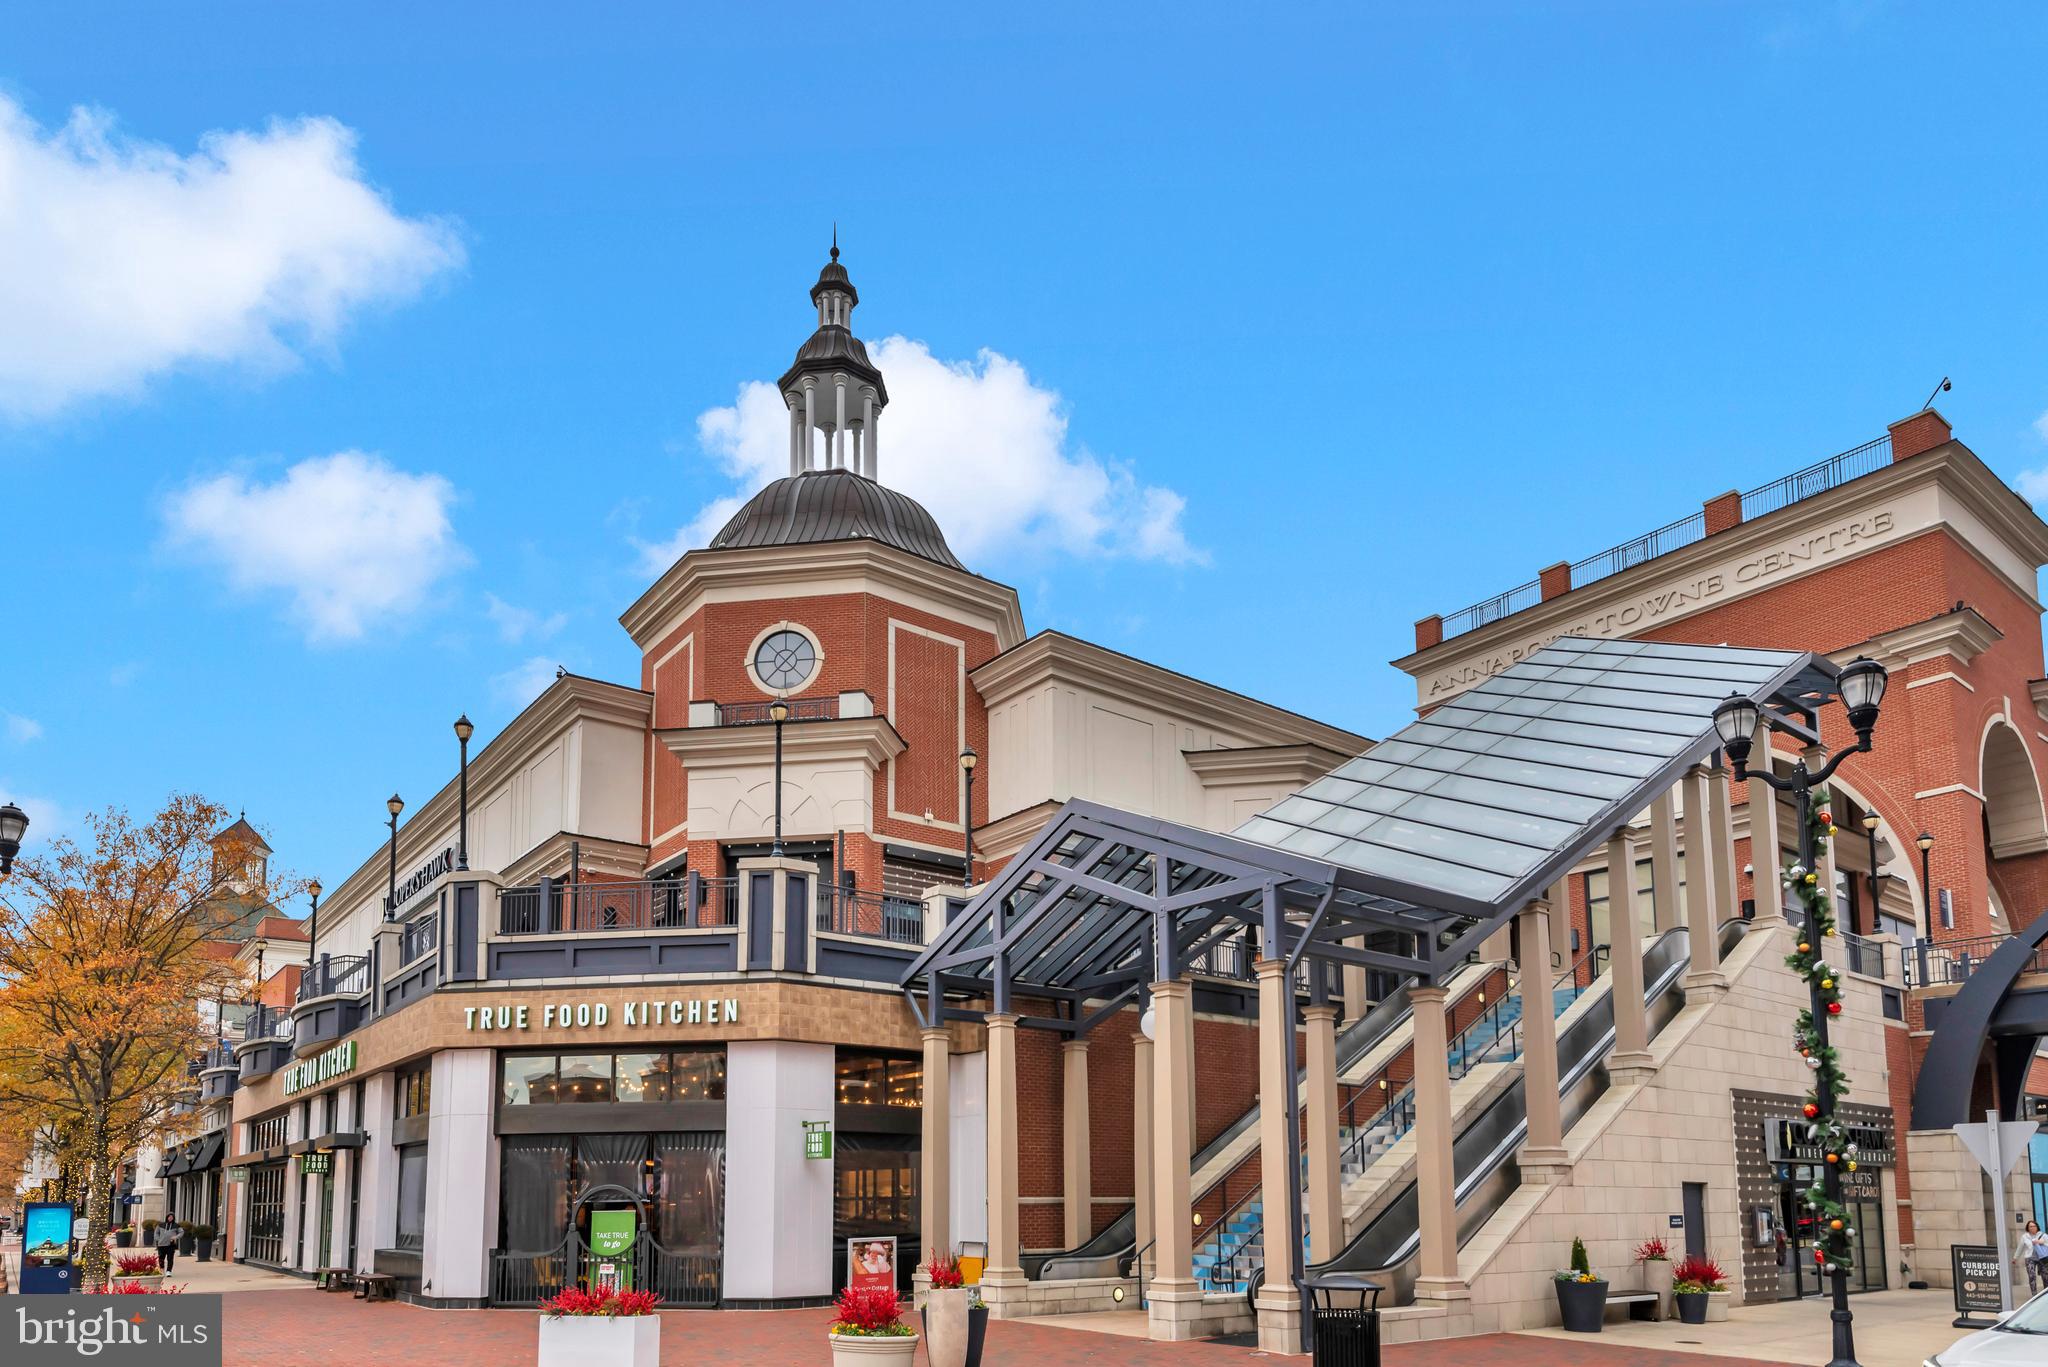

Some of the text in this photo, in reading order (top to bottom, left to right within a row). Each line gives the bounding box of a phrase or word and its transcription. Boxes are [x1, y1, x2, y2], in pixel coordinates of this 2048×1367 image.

[1595, 573, 1725, 634] TOWNE
[1734, 510, 1895, 583] CENTRE
[464, 998, 740, 1030] TRUE FOOD KITCHEN
[284, 1040, 353, 1096] TRUE FOOD KITCHEN
[306, 1154, 329, 1162] TRUE
[306, 1161, 328, 1169] FOOD
[596, 1231, 629, 1239] TAKE TRUE
[603, 1240, 621, 1249] to go
[1961, 1261, 2000, 1271] CURBSIDE
[1965, 1268, 1997, 1277] PICK-UP
